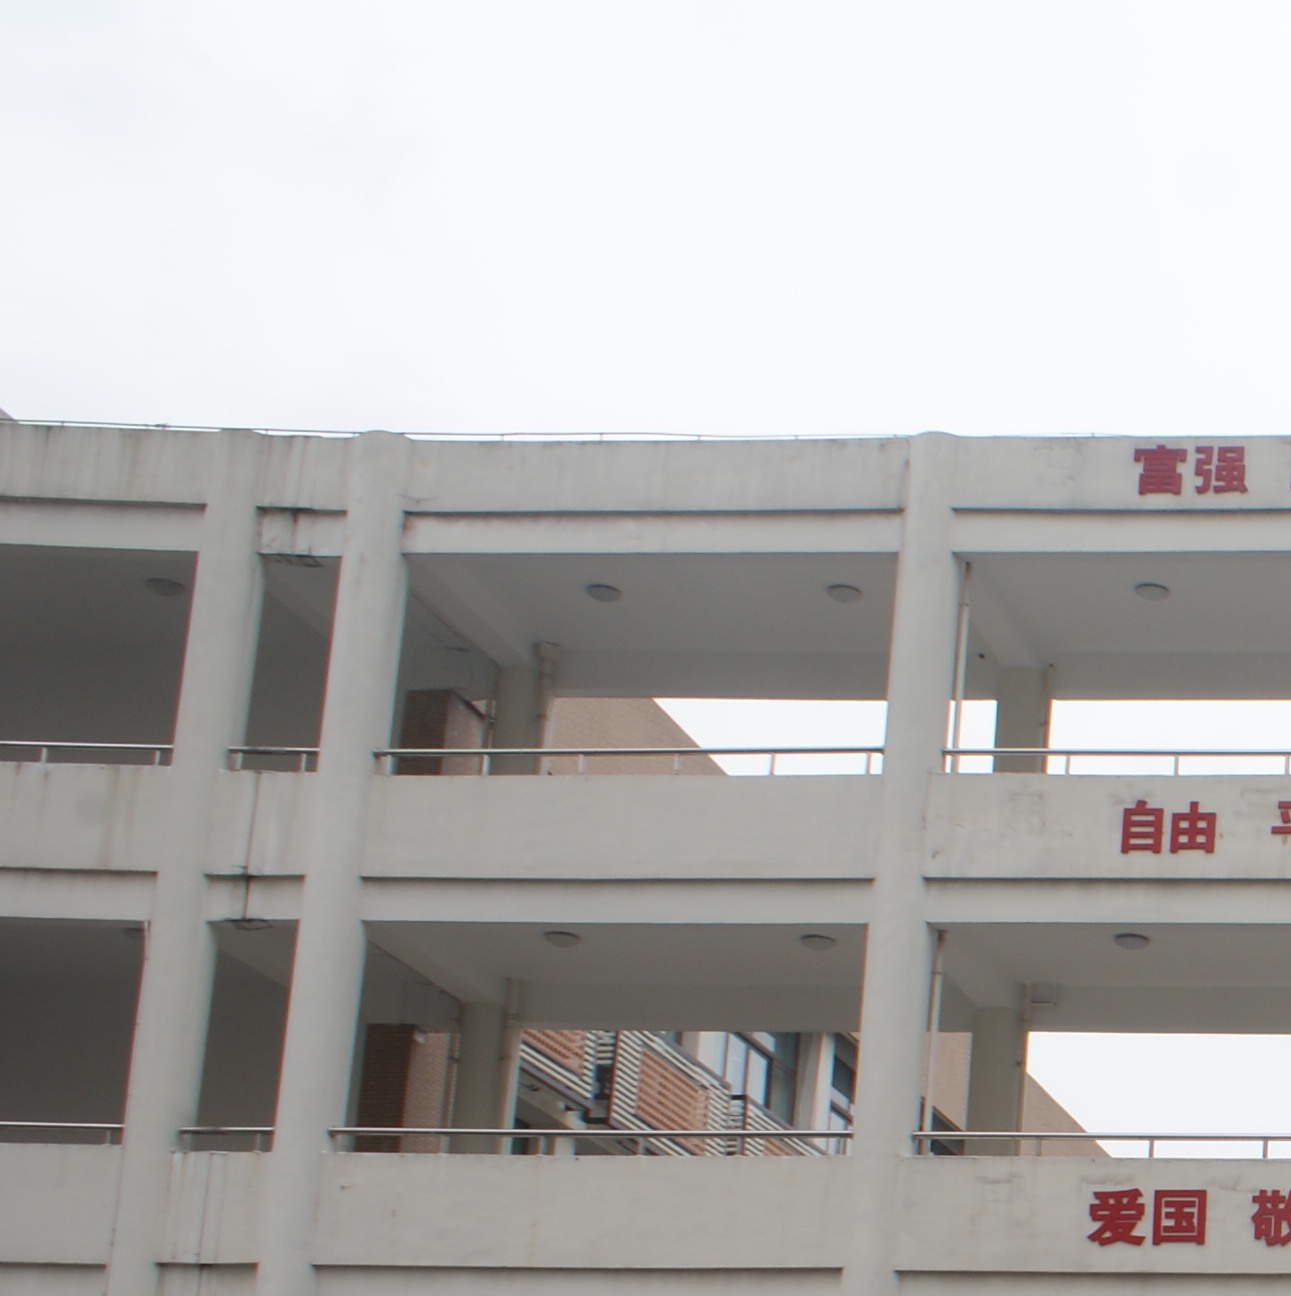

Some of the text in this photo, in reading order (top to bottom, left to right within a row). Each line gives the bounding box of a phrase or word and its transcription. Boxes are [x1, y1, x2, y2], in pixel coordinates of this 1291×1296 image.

[1134, 444, 1248, 497] 富强
[1120, 799, 1218, 855] 自由
[1088, 1187, 1209, 1246] 爱国
